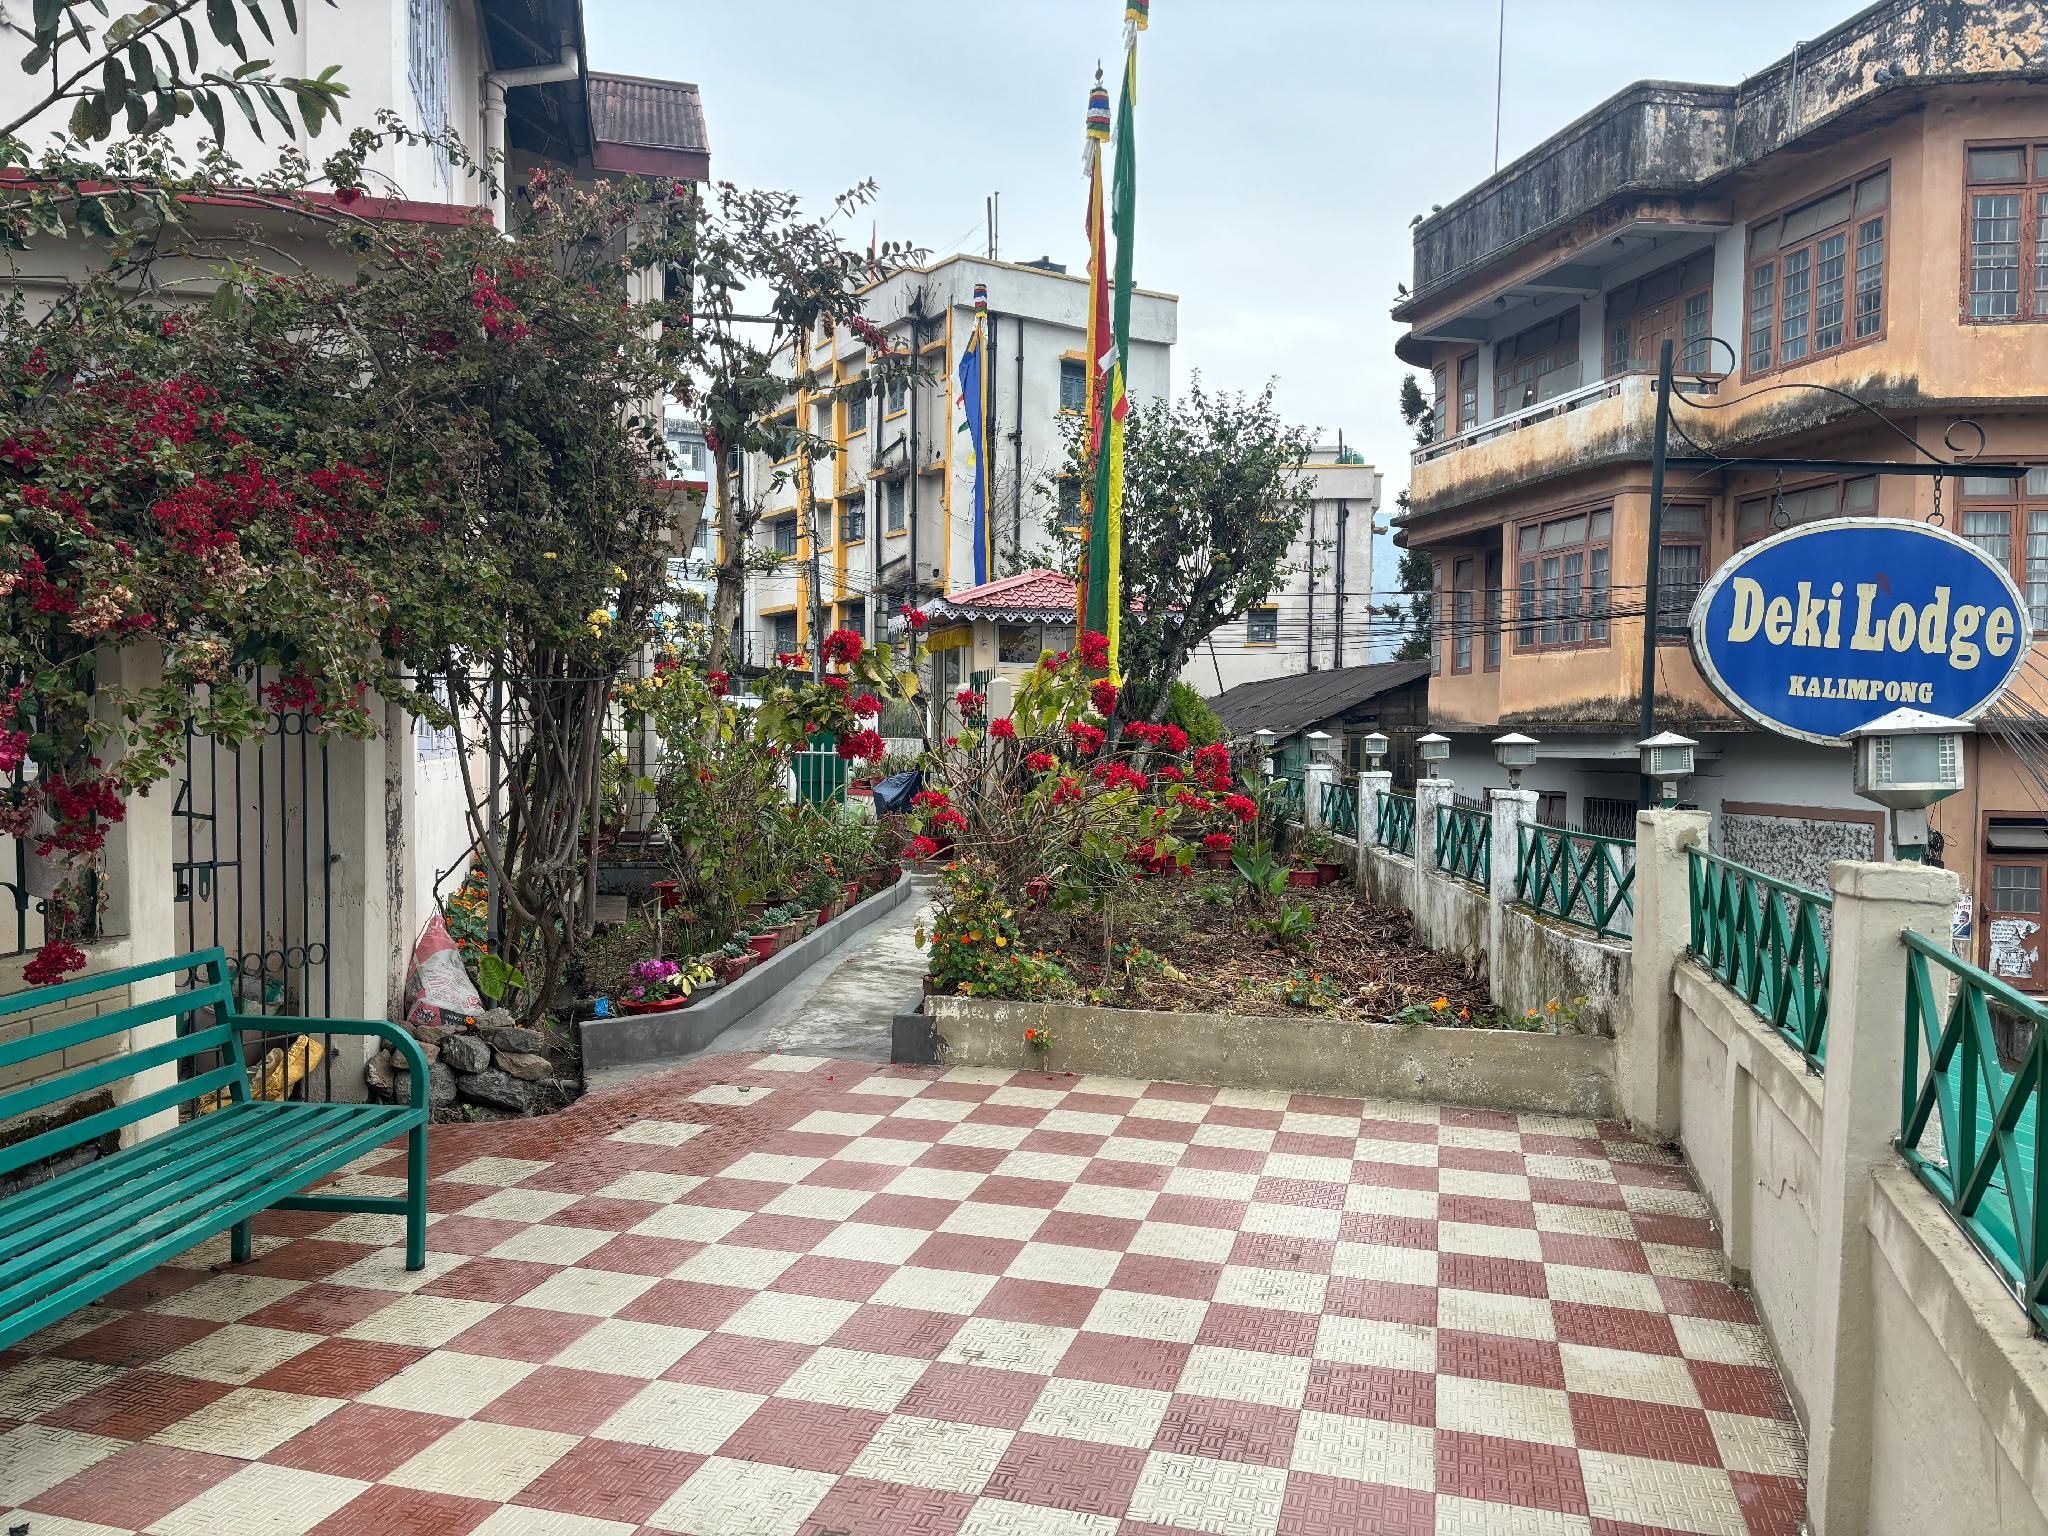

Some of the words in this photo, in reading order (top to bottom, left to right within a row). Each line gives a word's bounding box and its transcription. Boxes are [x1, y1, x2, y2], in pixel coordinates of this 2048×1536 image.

[1728, 577, 1843, 649] Deki
[1850, 584, 2014, 671] Lodge
[1788, 676, 1933, 704] KALIMPONG
